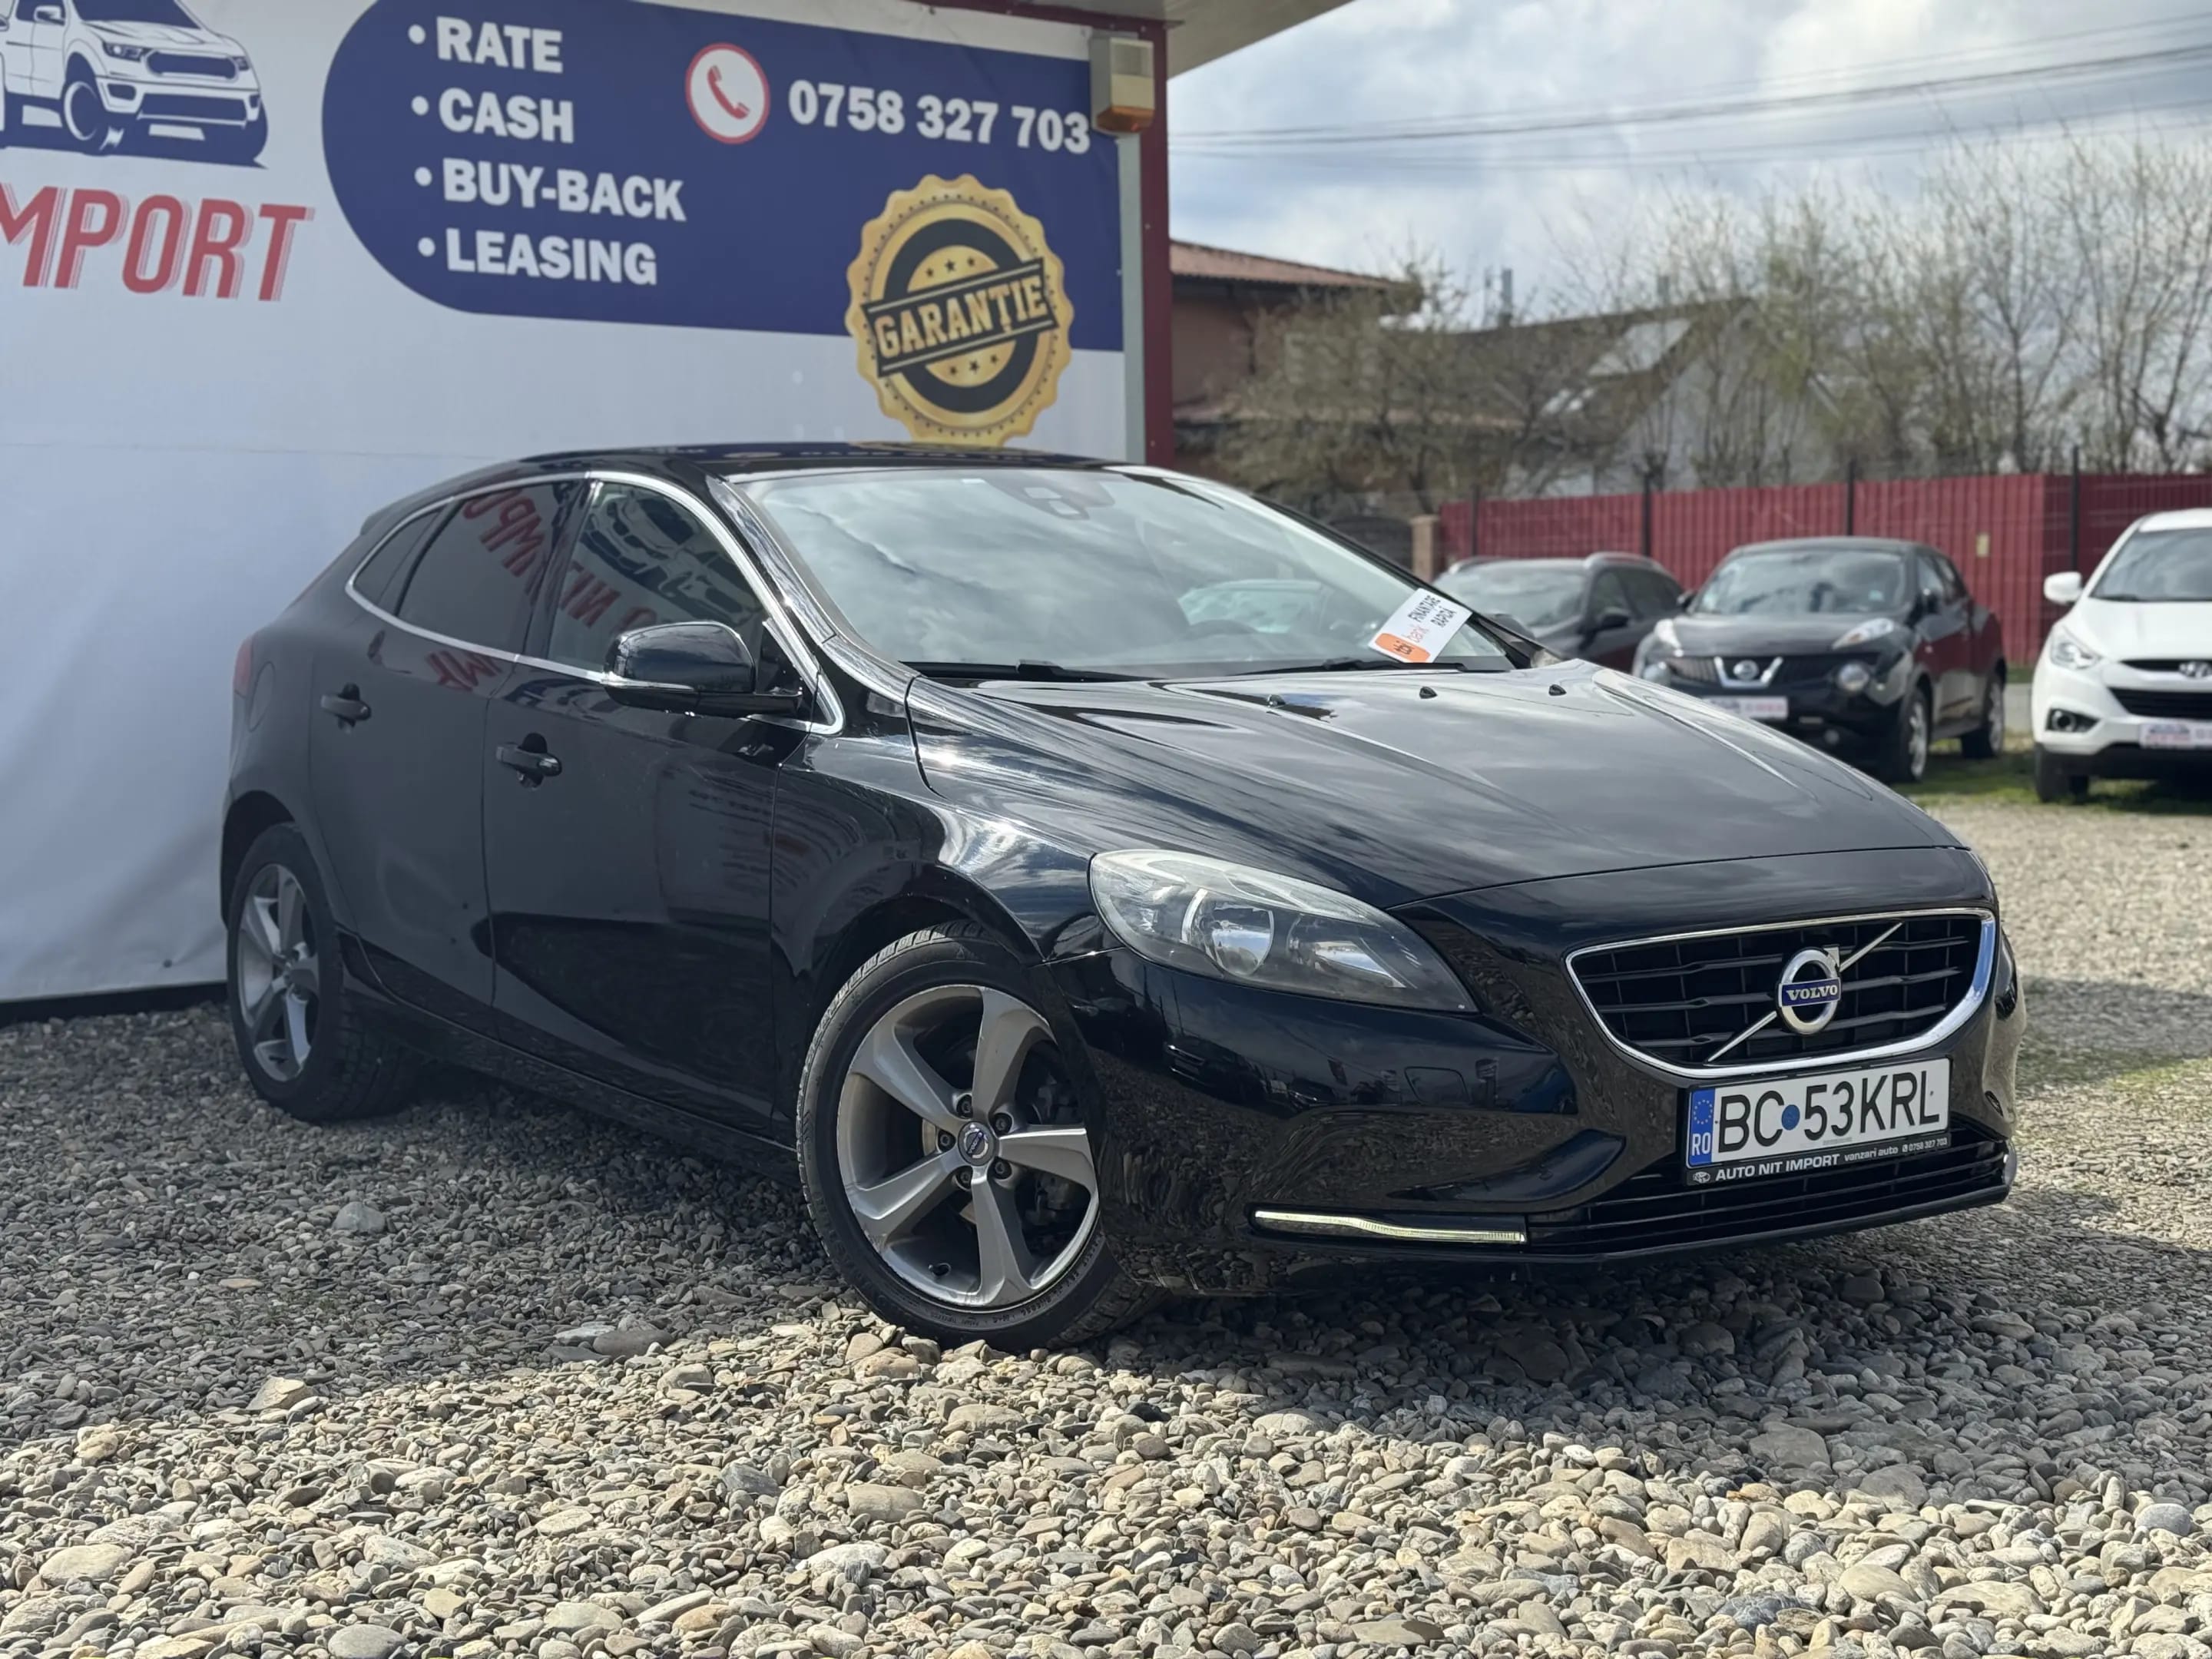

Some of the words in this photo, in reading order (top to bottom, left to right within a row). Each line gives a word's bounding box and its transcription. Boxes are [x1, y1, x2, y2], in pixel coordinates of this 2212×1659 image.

[436, 16, 563, 73] RATE
[439, 88, 574, 144] CASH
[788, 79, 906, 134] 0758
[916, 94, 998, 144] 327
[1011, 105, 1091, 154] 703
[442, 157, 687, 221] BUY-BACK
[445, 228, 657, 286] LEASING
[1786, 985, 1838, 1001] VOLVO
[1692, 1132, 1711, 1157] RO
[1715, 1164, 1755, 1181] AUTO
[1758, 1161, 1783, 1176] NIT
[1785, 1154, 1840, 1171] IMPORT
[1844, 1147, 1877, 1162] vanzari
[1878, 1147, 1899, 1156] auto
